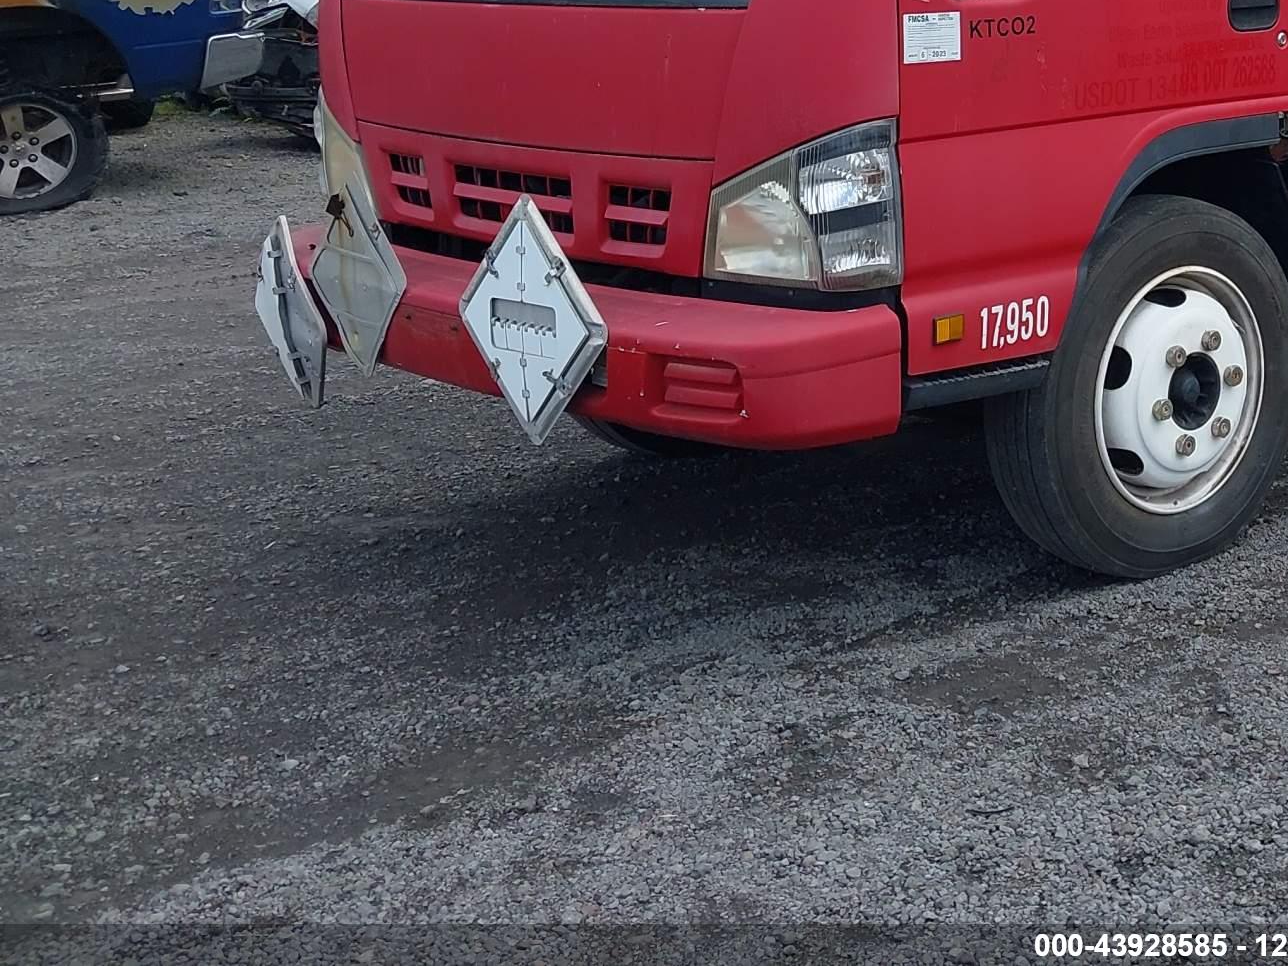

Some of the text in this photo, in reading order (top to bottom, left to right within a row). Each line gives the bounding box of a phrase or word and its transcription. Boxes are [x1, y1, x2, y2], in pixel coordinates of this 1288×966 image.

[908, 15, 930, 23] FMCSA
[1074, 77, 1139, 111] USDOT
[980, 295, 1049, 350] 17,950
